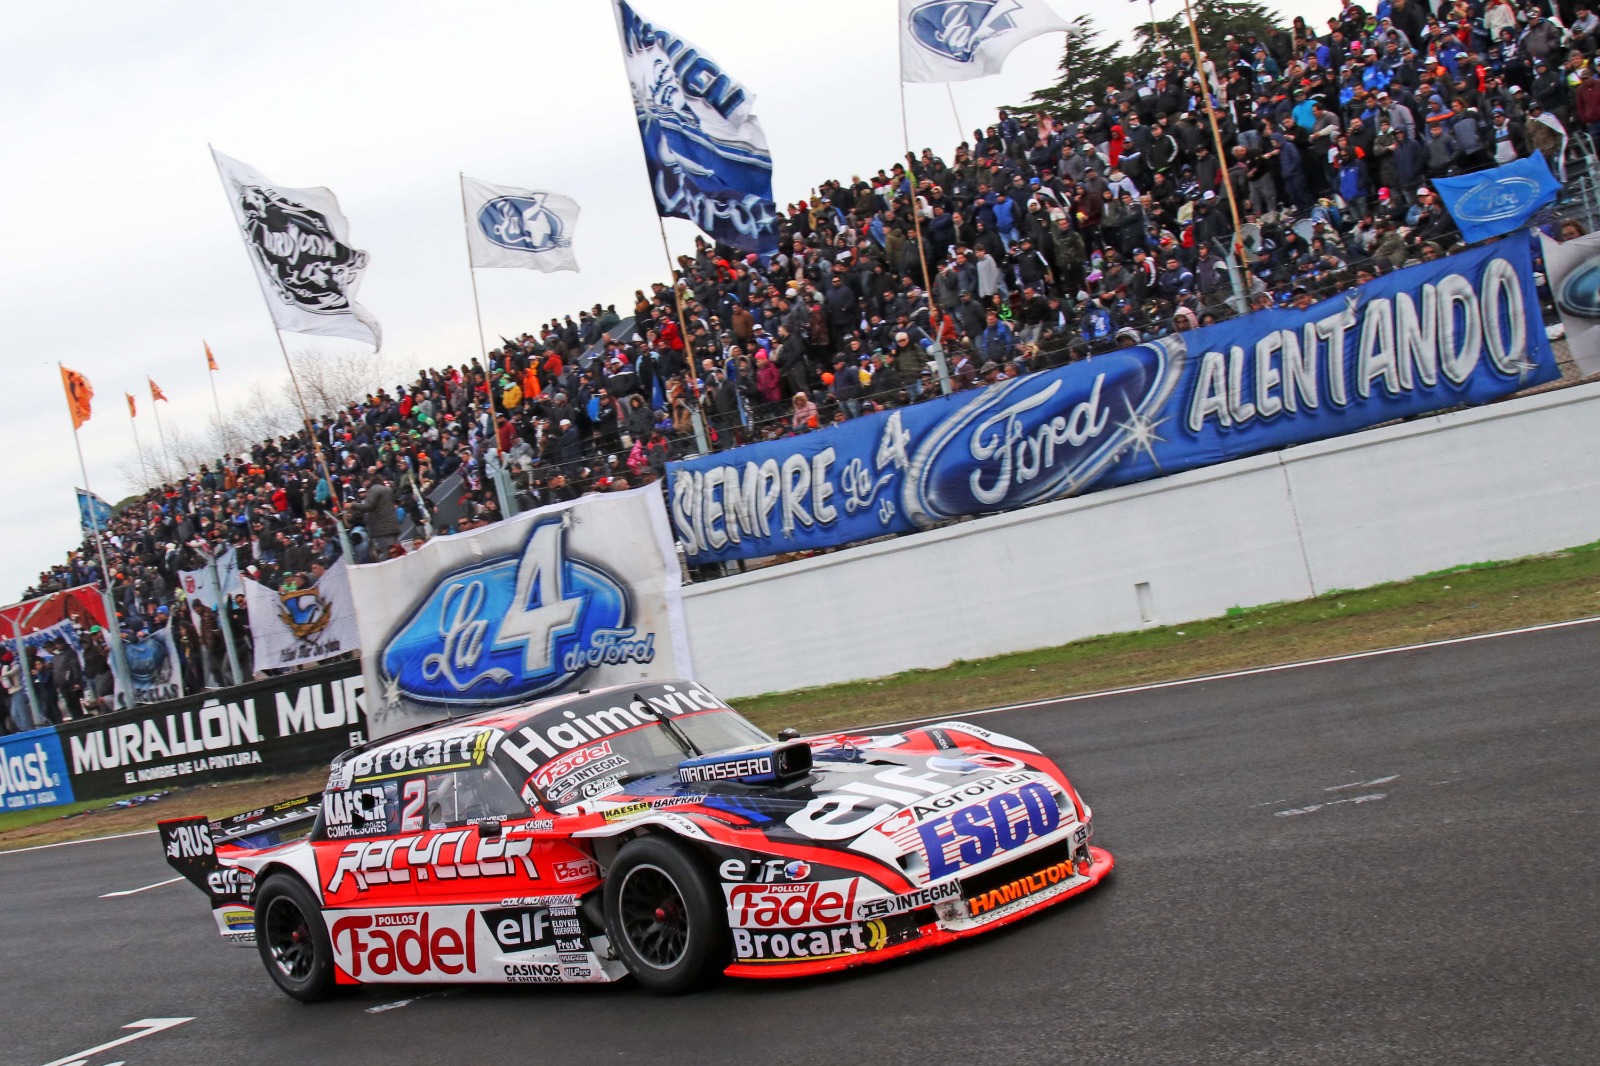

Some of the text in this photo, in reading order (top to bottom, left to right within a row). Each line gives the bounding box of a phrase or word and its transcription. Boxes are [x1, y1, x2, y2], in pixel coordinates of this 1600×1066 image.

[1188, 258, 1529, 432] ALENTANDO
[672, 446, 838, 556] SIEMPRE
[876, 409, 912, 474] 4
[970, 373, 1110, 505] Ford
[421, 579, 515, 691] La
[493, 522, 585, 676] 4
[587, 627, 655, 666] Ford
[350, 731, 368, 747] EL
[354, 732, 475, 777] Brocart
[125, 751, 262, 784] EL NOMBRE DE LA PINTURA
[536, 741, 612, 787] Fadel
[574, 756, 626, 782] INTEGRA
[680, 756, 772, 783] MANASSERO
[402, 779, 426, 832] 2
[605, 802, 649, 818] KAESER
[785, 765, 954, 841] elf
[177, 824, 214, 858] RUS
[525, 818, 554, 830] CASINOS
[916, 782, 1062, 881] ESCO
[208, 868, 238, 894] elf
[771, 884, 806, 893] POLLOS
[896, 881, 960, 911] INTEGRA
[968, 859, 1075, 917] HAMILTON
[729, 877, 860, 927] Fadel
[378, 914, 415, 926] POLLOS
[496, 908, 551, 946] elf
[553, 926, 581, 936] GUERRERO
[331, 908, 477, 977] Fadel
[732, 922, 868, 958] Brocart
[503, 963, 561, 976] CASINOS
